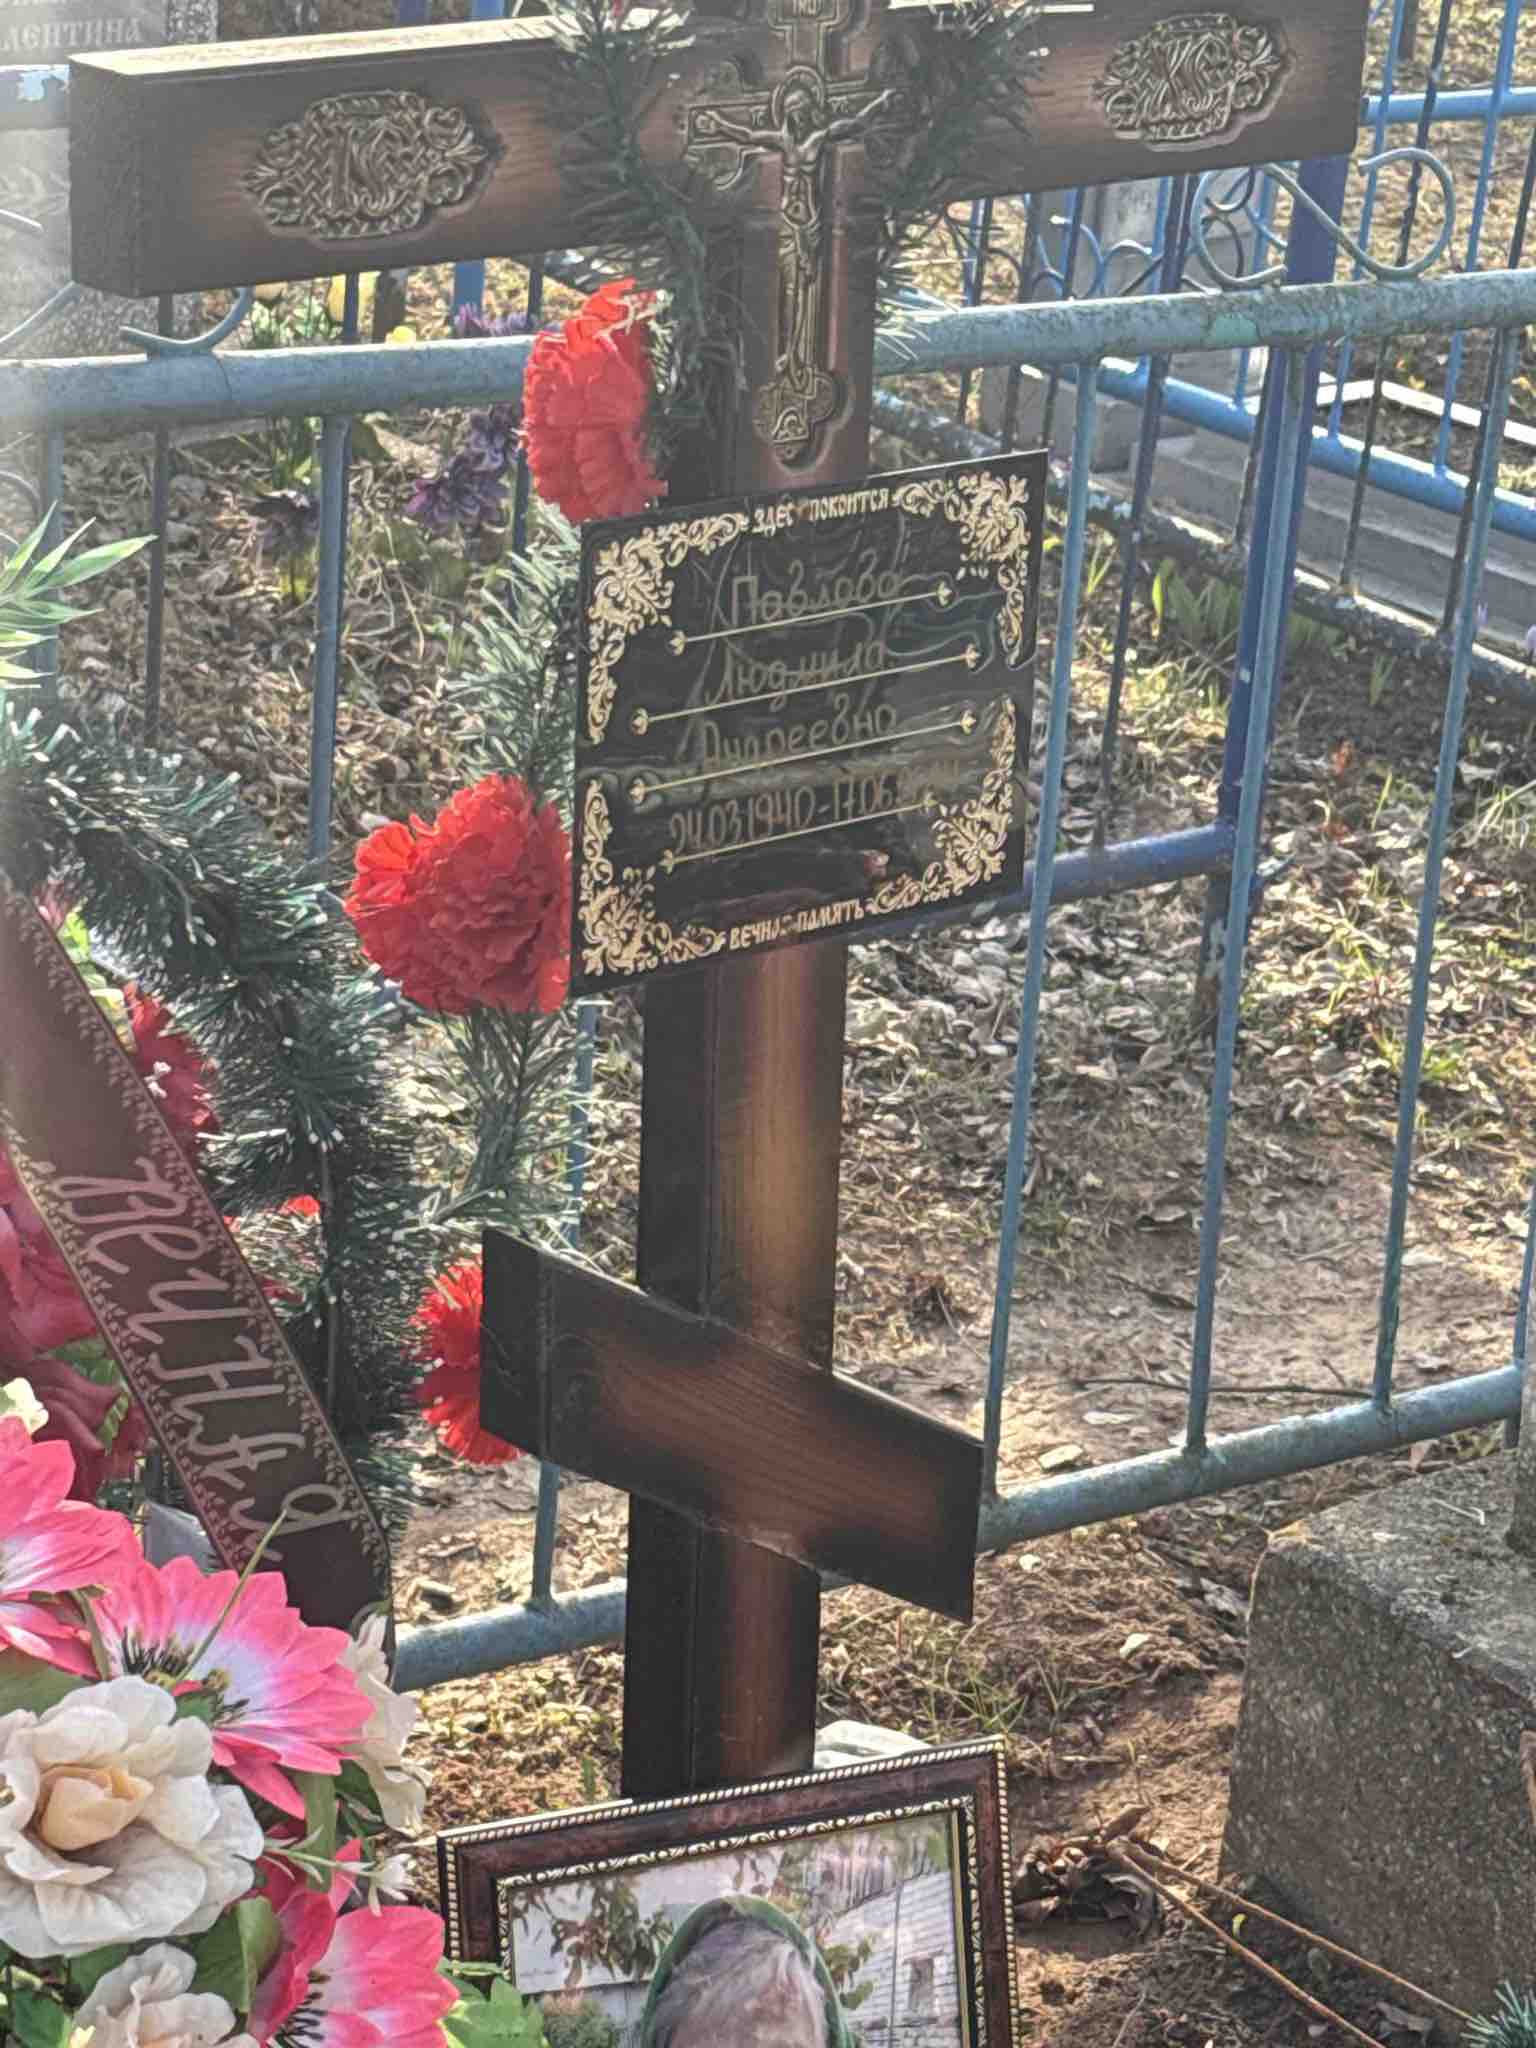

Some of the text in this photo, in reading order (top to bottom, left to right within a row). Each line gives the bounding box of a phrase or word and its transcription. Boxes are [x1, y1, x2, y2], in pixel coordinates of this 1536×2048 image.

[752, 488, 889, 536] ЗДЕС ПОКОИТСЯ
[731, 549, 901, 625] Павлова
[705, 641, 885, 712] Людмила
[797, 898, 864, 932] ПАМЯТЬ
